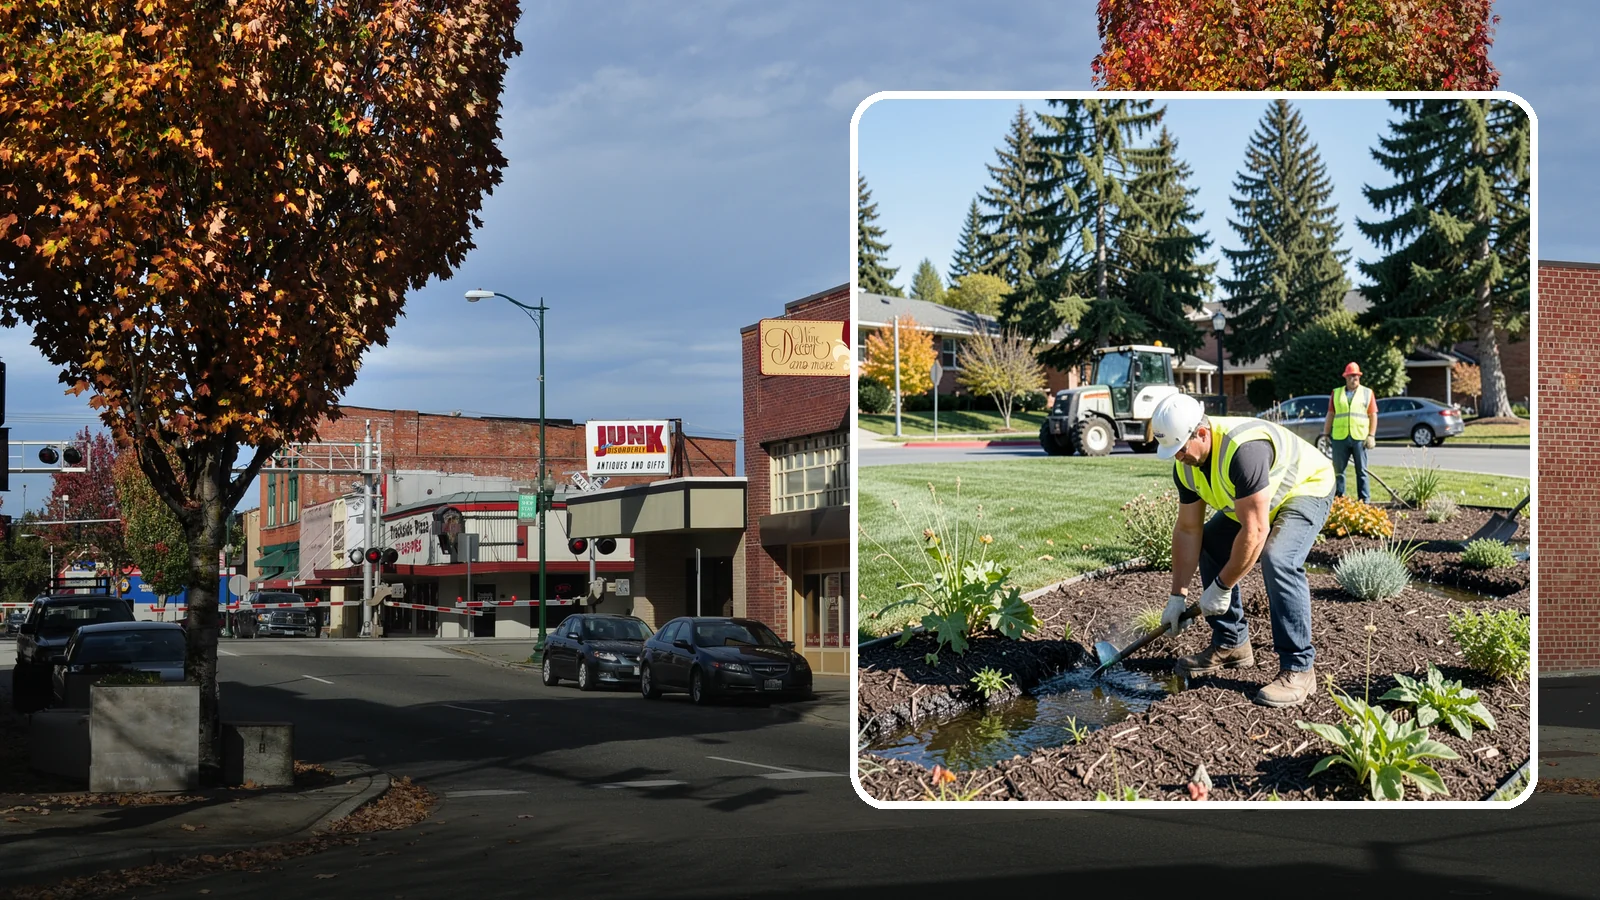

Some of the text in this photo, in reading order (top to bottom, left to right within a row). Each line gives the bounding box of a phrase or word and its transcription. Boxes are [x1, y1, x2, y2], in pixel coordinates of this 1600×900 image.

[765, 328, 830, 365] Decor
[595, 425, 665, 457] JUNK
[607, 446, 645, 454] DISORDERLY
[597, 461, 665, 470] ANTIQUES AND GIFTS
[390, 520, 429, 540] Trackside Pizza
